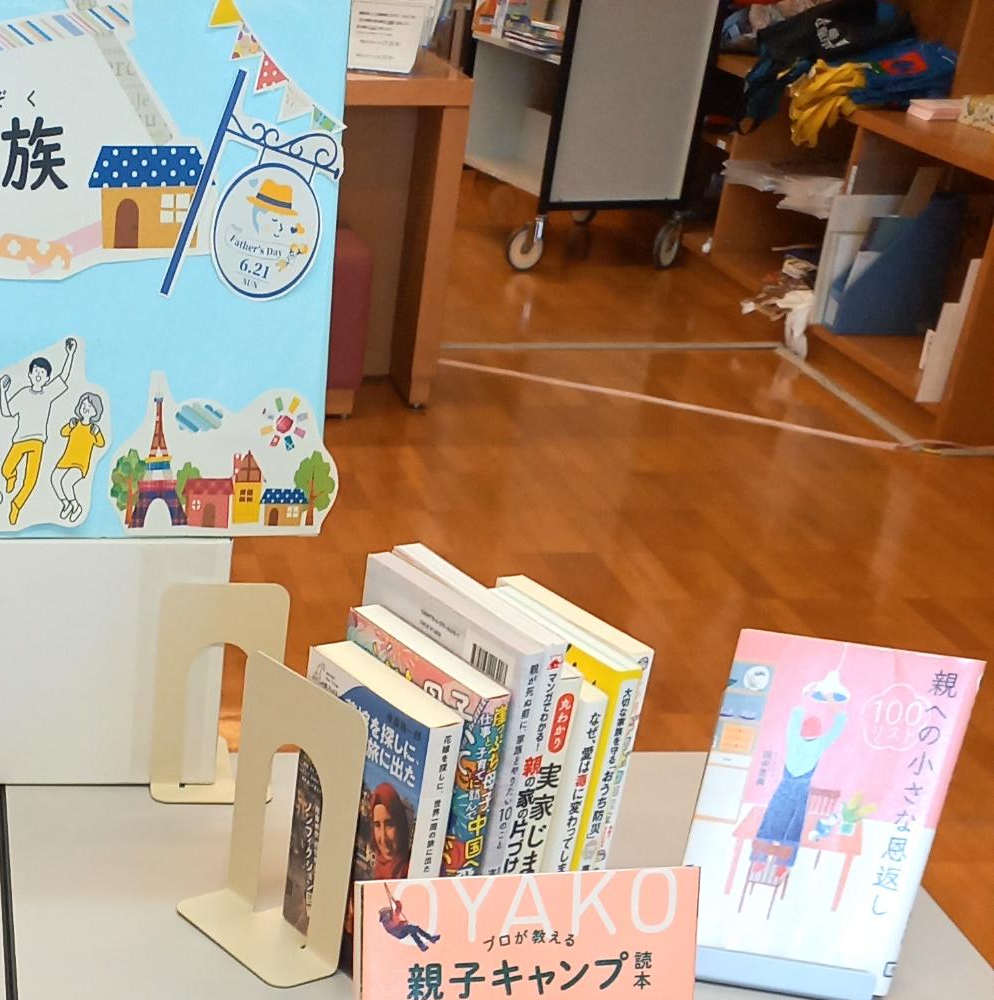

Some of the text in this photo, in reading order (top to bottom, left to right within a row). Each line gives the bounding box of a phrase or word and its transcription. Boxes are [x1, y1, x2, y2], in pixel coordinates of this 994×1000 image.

[229, 234, 282, 257] Father's Day
[239, 258, 270, 279] 6.21
[553, 699, 572, 750] 丸わかり
[873, 699, 923, 726] 100
[871, 669, 959, 916] 親への小さな恩返し
[393, 867, 678, 948] OYAKO
[483, 929, 575, 952] プロが教える
